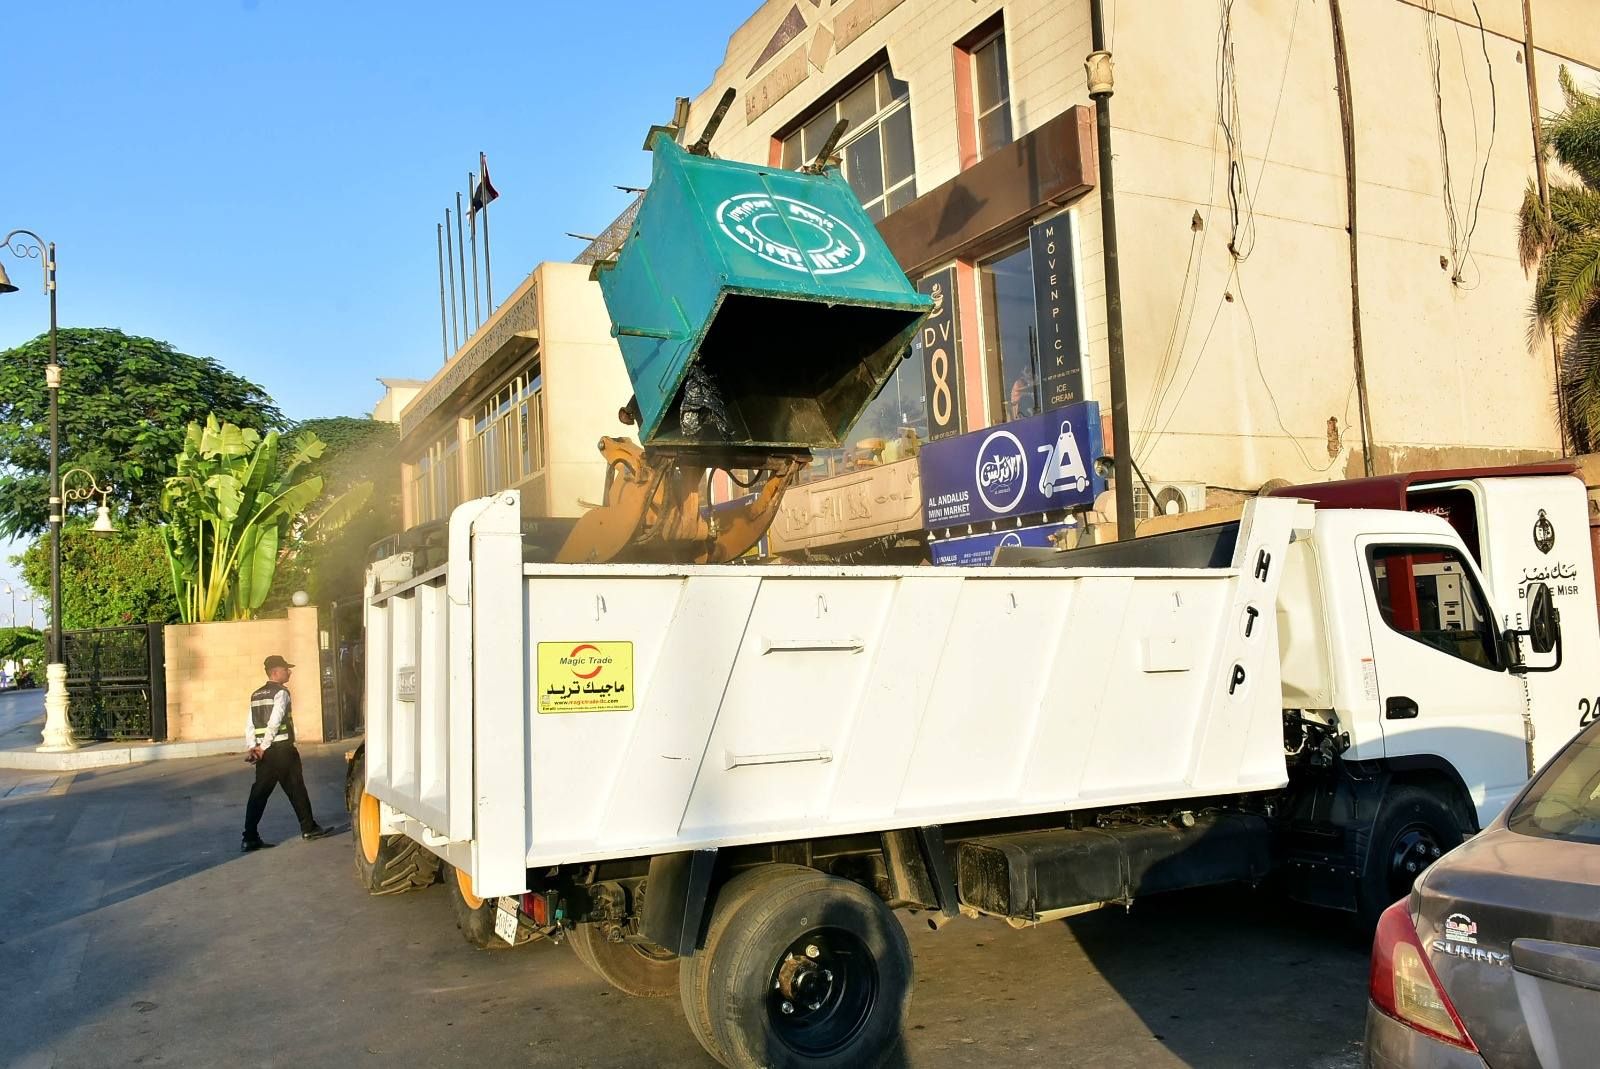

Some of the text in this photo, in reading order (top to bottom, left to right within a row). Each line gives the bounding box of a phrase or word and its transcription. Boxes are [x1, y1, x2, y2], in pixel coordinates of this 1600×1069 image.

[1056, 383, 1067, 393] ICE
[1051, 392, 1074, 404] CREAM
[928, 490, 969, 508] AL ANDALUS
[928, 508, 942, 519] MINI
[943, 503, 970, 516] MARKET
[559, 656, 613, 667] Magic Trade
[547, 681, 625, 699] ماجيك تريد
